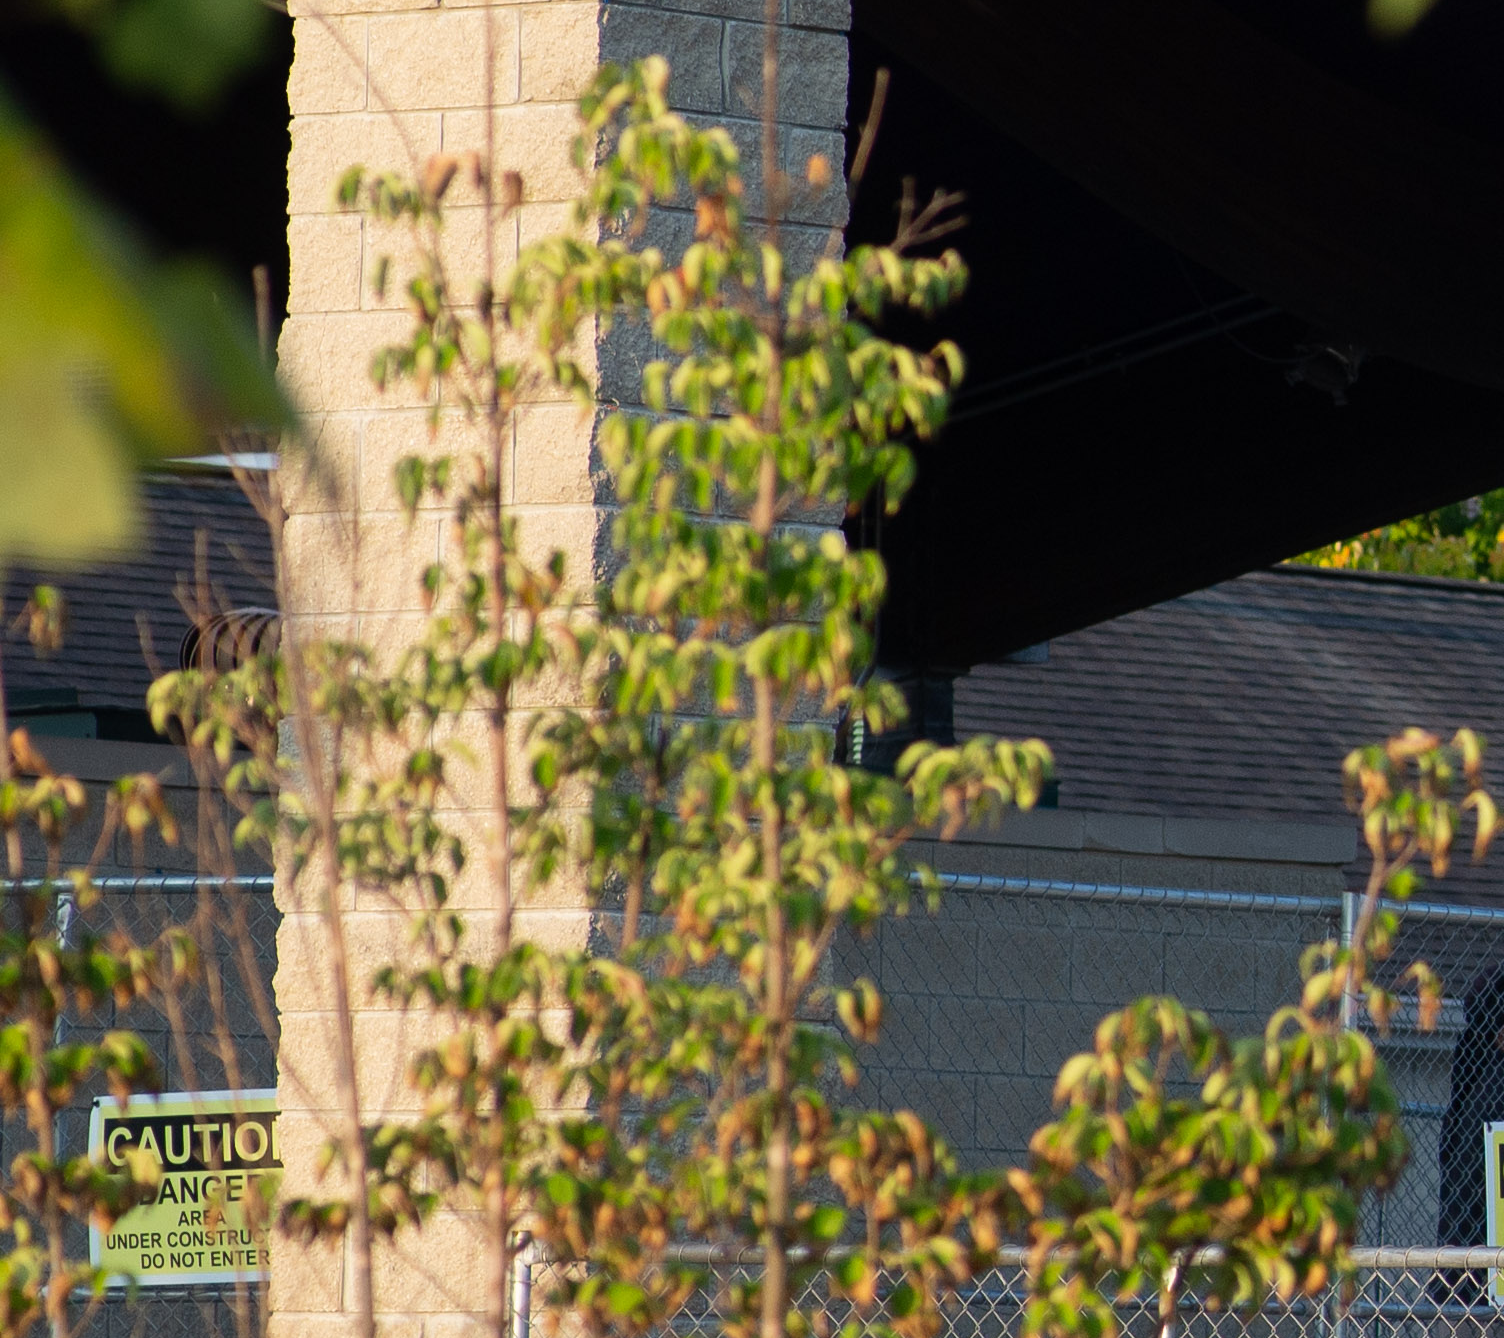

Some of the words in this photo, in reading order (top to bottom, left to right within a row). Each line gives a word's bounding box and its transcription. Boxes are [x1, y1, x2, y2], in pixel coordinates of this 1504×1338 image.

[107, 1121, 281, 1167] CAUTIO
[106, 1233, 162, 1250] UNDER
[167, 1228, 271, 1248] CONSTRUC
[141, 1253, 165, 1270] DO
[170, 1252, 205, 1269] NOT
[210, 1249, 270, 1267] ENTER
